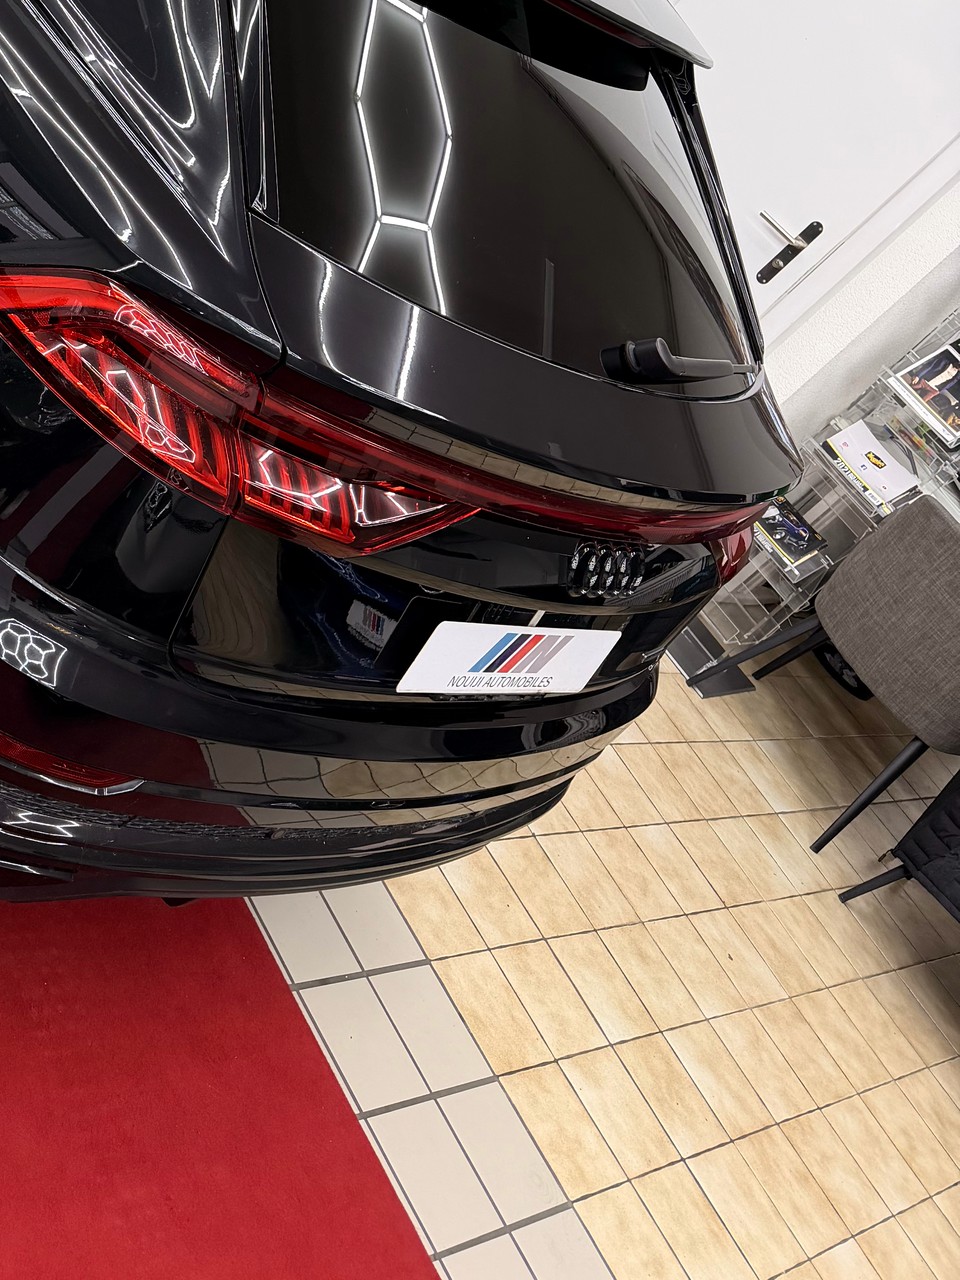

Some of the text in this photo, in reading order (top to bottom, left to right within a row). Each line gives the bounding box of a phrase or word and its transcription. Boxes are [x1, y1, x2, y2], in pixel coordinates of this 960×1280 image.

[834, 457, 851, 476] 2021
[446, 675, 553, 688] NOUIJI AUTOMOBILES
